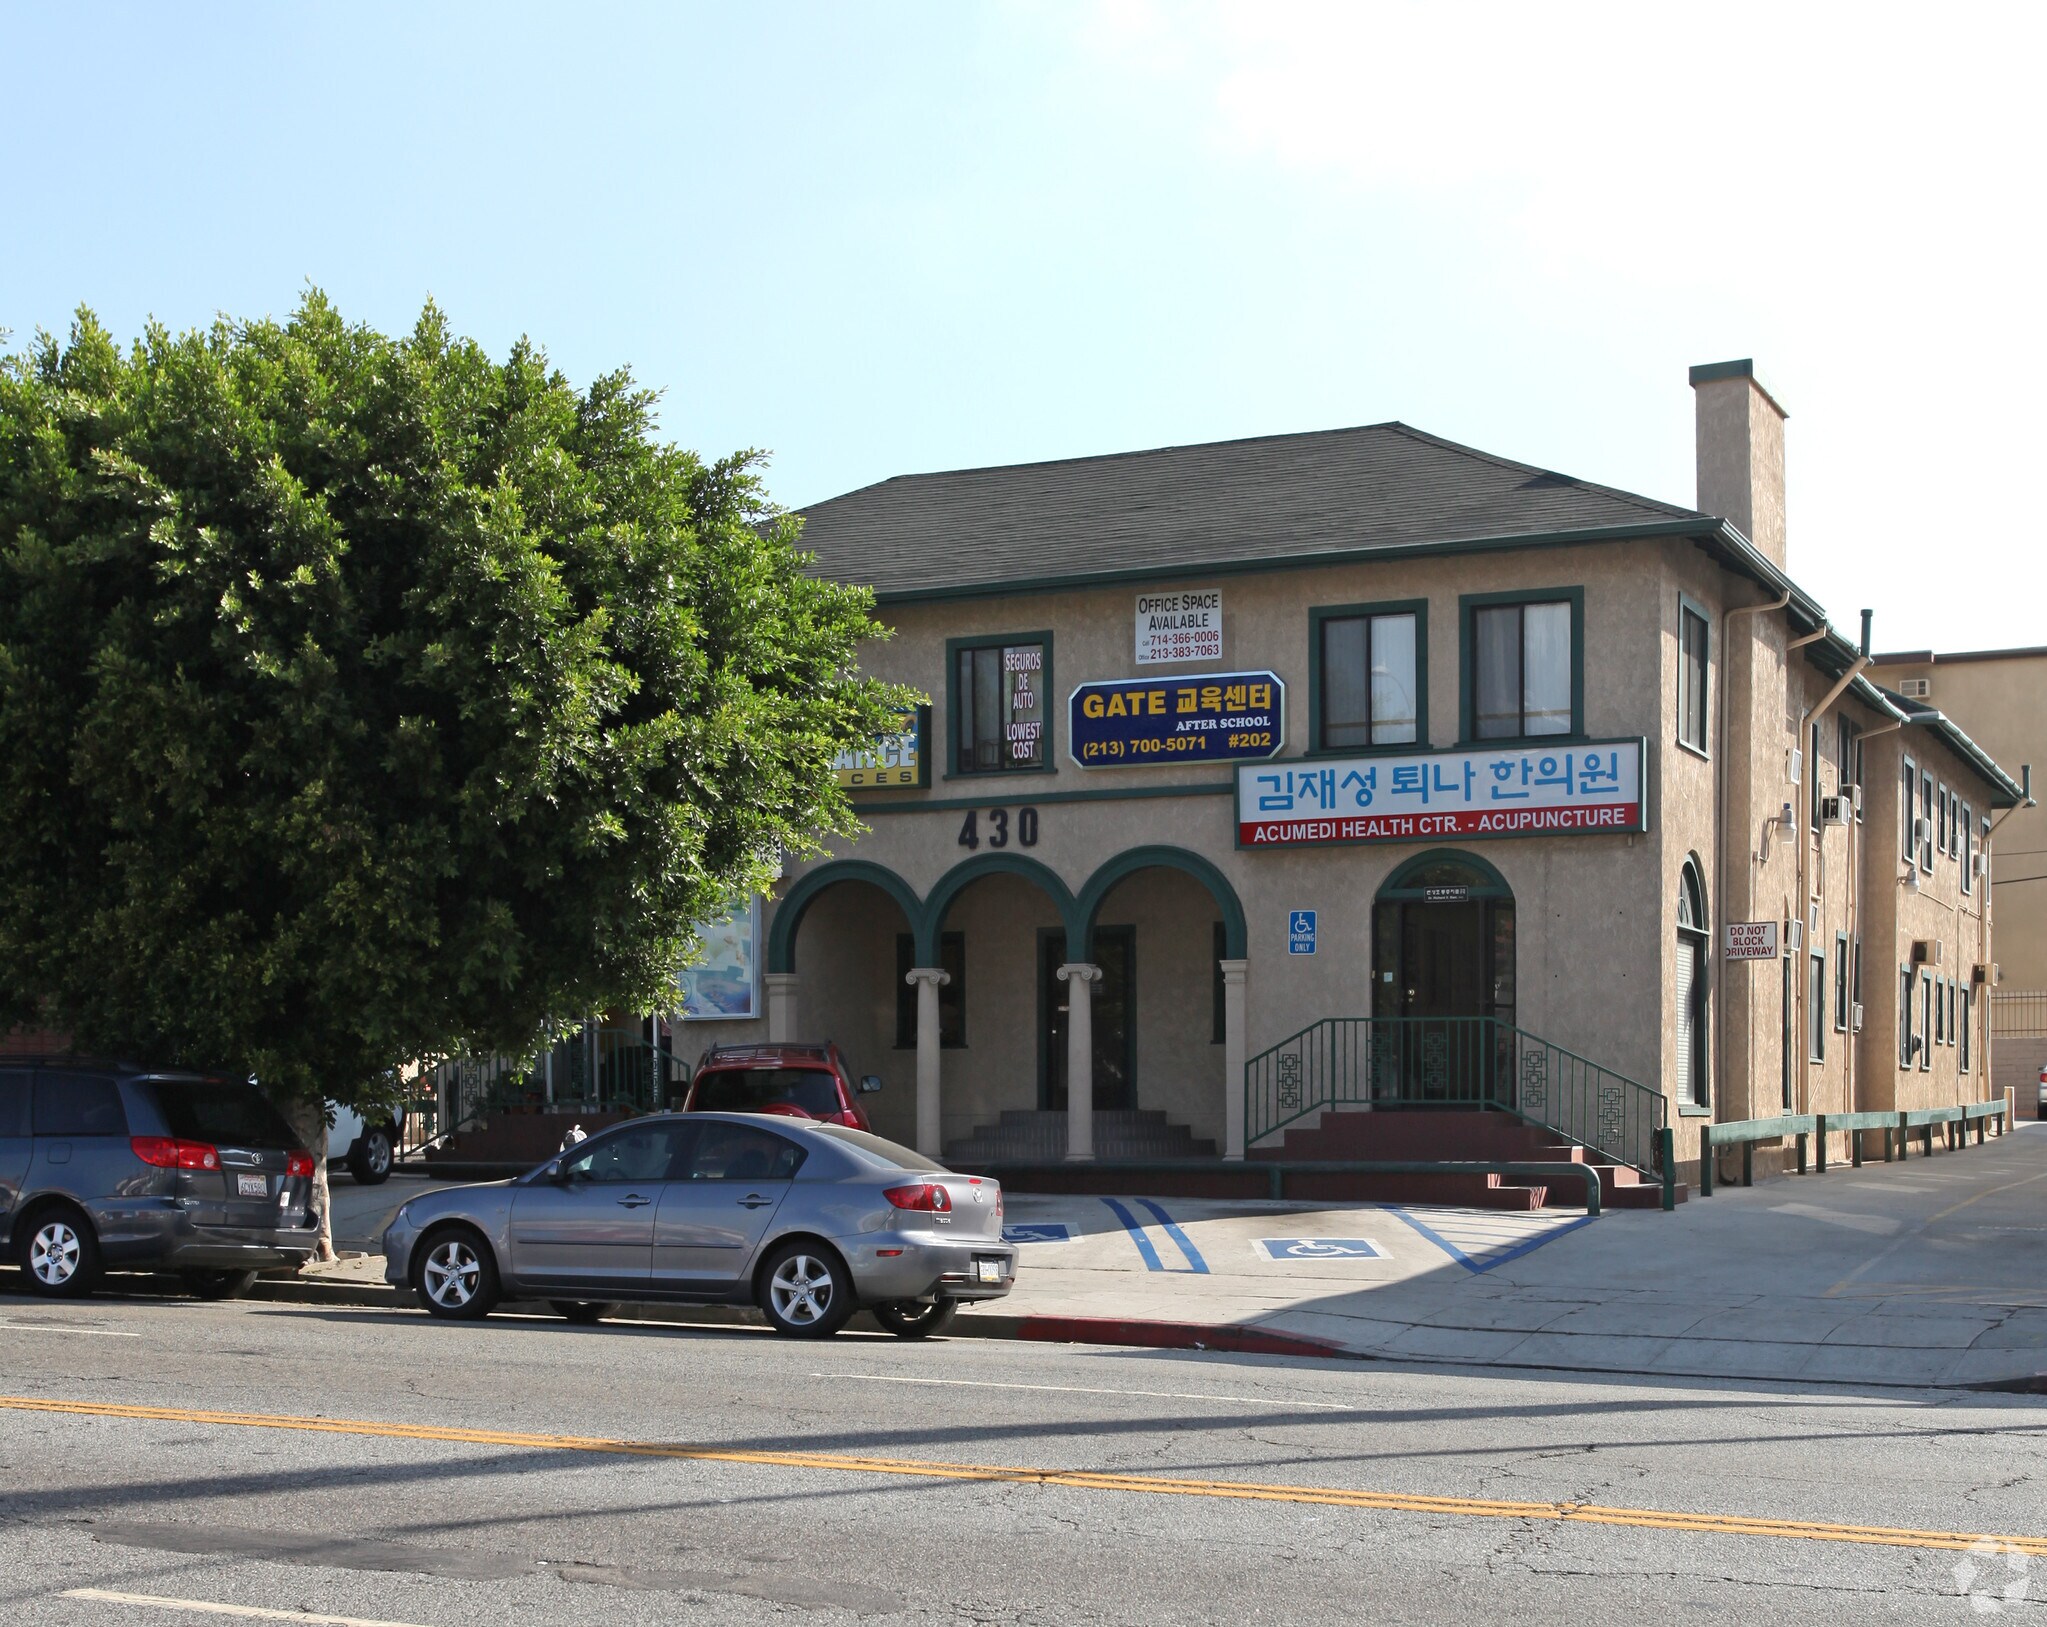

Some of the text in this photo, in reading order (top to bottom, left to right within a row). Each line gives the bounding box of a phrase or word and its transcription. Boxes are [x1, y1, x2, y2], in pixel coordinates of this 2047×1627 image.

[1139, 594, 1218, 614] OFFICE SPACE
[1148, 613, 1209, 631] AVAILABLE
[1150, 630, 1219, 646] 714-366-0006
[1150, 644, 1219, 660] 213-383-7063
[1005, 652, 1041, 672] SEGUROS
[1017, 673, 1029, 691] DE
[1012, 691, 1034, 710] AUTO
[1082, 683, 1272, 719] GATE 교육센터
[1006, 722, 1041, 740] LOWEST
[1175, 716, 1271, 732] AFTER SCHOOL
[831, 733, 916, 771] ANCE
[1012, 741, 1035, 760] COST
[1082, 732, 1271, 761] (213) 700-5071 #202
[851, 771, 911, 784] CES
[1257, 752, 1621, 812] 김재성 퇴나 한의원
[958, 807, 1039, 849] 430
[1253, 820, 1337, 843] ACUMEDI
[1342, 817, 1414, 838] HEALTH
[1418, 815, 1462, 834] CTR.
[1477, 808, 1626, 832] ACUPUNCTURE
[1291, 933, 1314, 942] PARKING
[1730, 926, 1767, 935] DO NOT
[1295, 943, 1310, 951] ONLY
[1733, 936, 1764, 945] BLOCK
